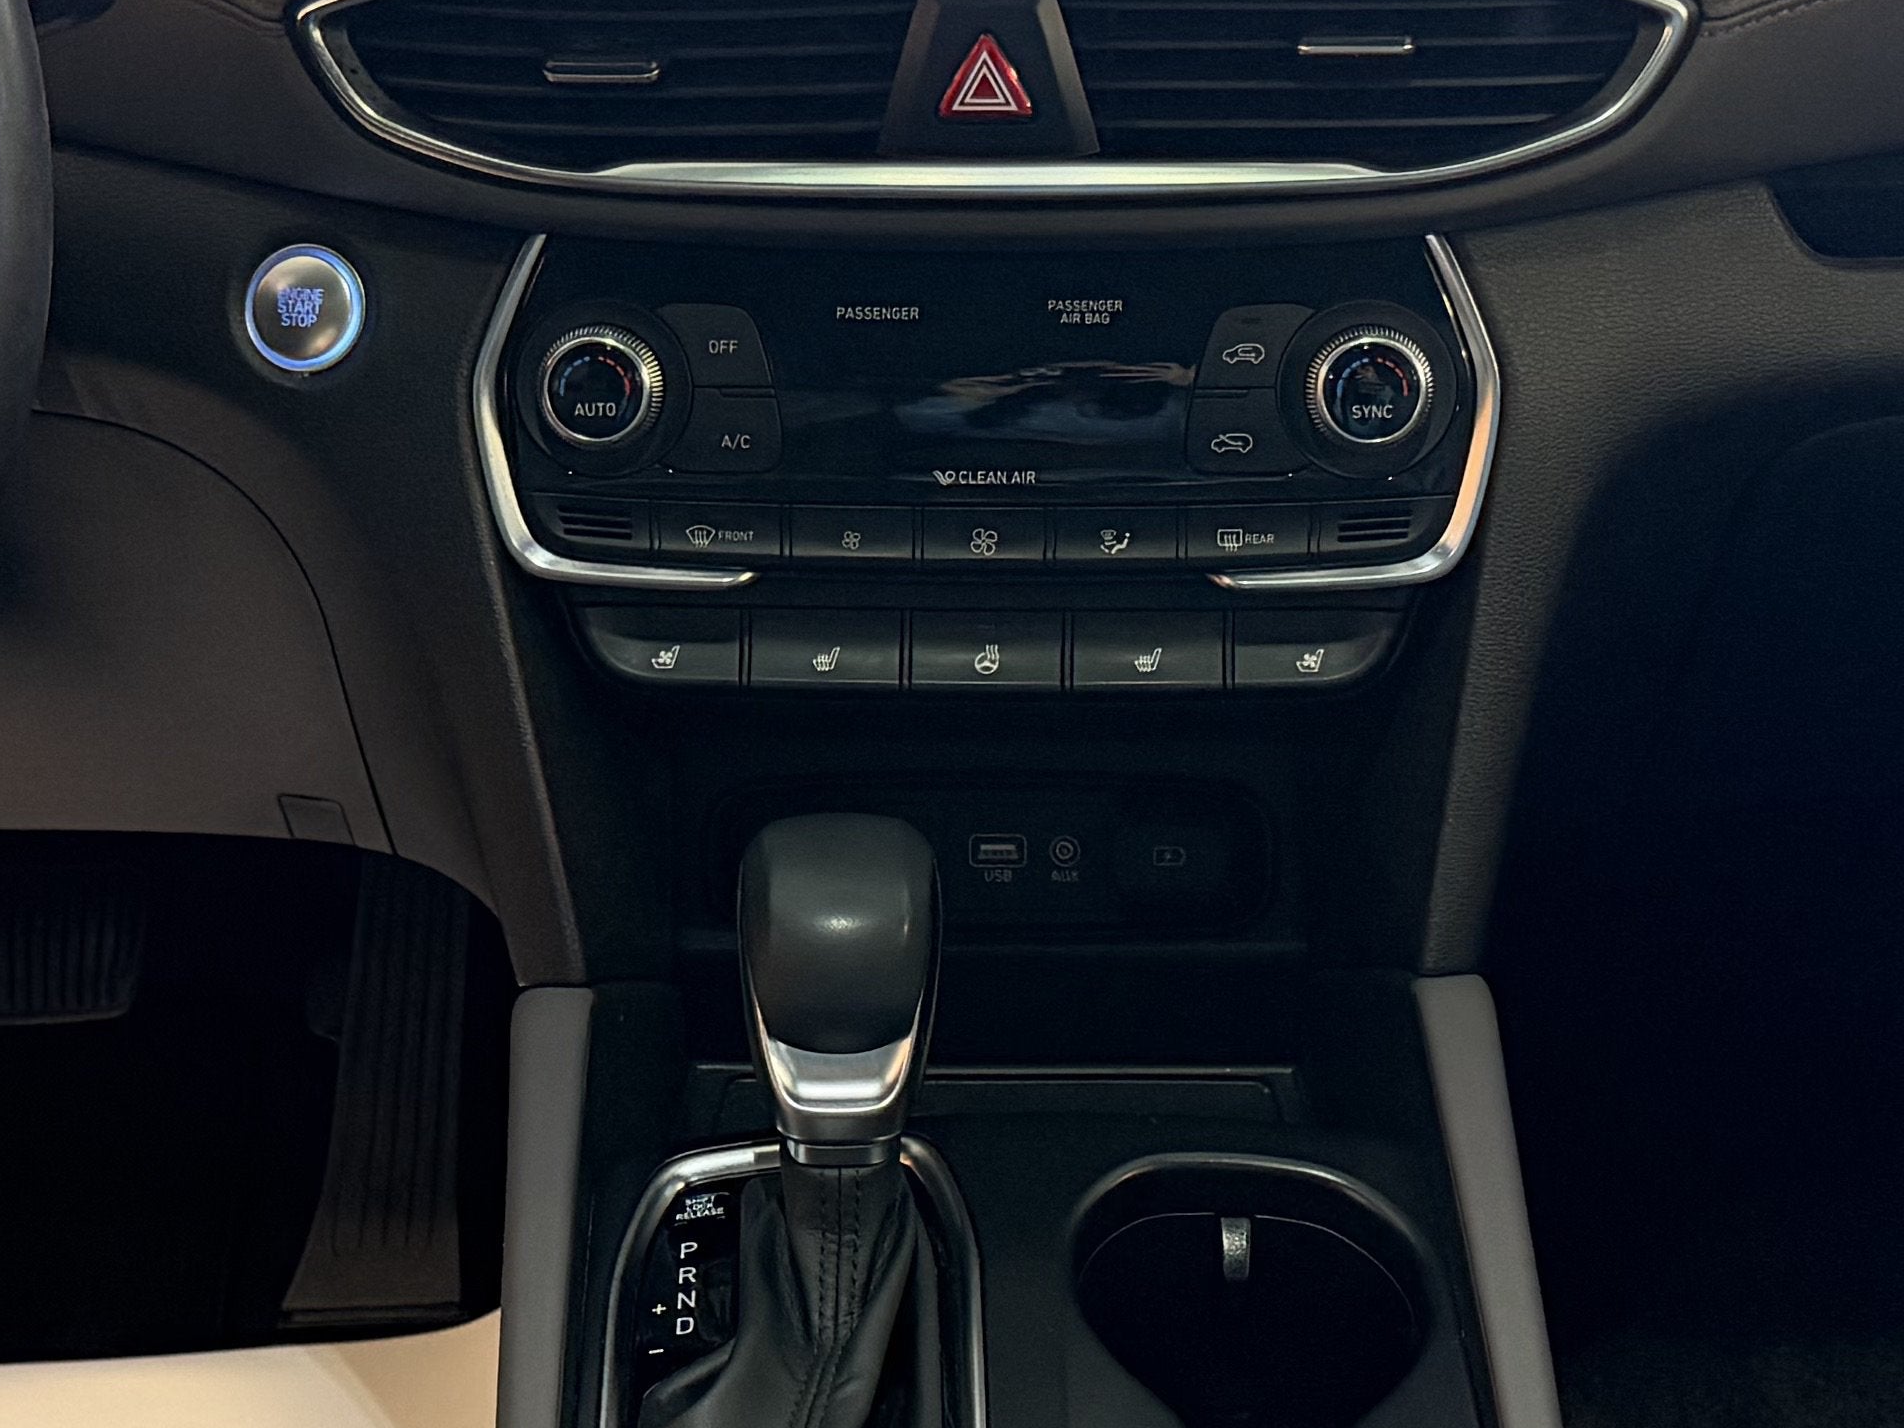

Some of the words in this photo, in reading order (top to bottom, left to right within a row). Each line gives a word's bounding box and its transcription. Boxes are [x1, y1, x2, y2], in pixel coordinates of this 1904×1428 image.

[277, 288, 325, 301] ENGINE
[277, 299, 322, 315] START
[836, 307, 920, 320] PASSENGER
[1047, 300, 1123, 312] PASSENGER
[281, 313, 318, 328] STOP
[1060, 312, 1081, 324] AIR
[1084, 312, 1110, 325] BAG
[708, 339, 739, 354] OFF
[574, 402, 617, 417] AUTO
[1352, 404, 1393, 419] SYNC
[721, 434, 751, 450] A/C
[958, 470, 1007, 485] CLEAN
[1010, 470, 1036, 485] AIR
[717, 530, 754, 542] FRONT
[1244, 532, 1275, 545] REAR
[675, 1207, 725, 1220] RELEASE
[680, 1241, 698, 1259] P
[678, 1266, 697, 1284] R
[677, 1290, 697, 1310] N
[675, 1316, 695, 1335] D
